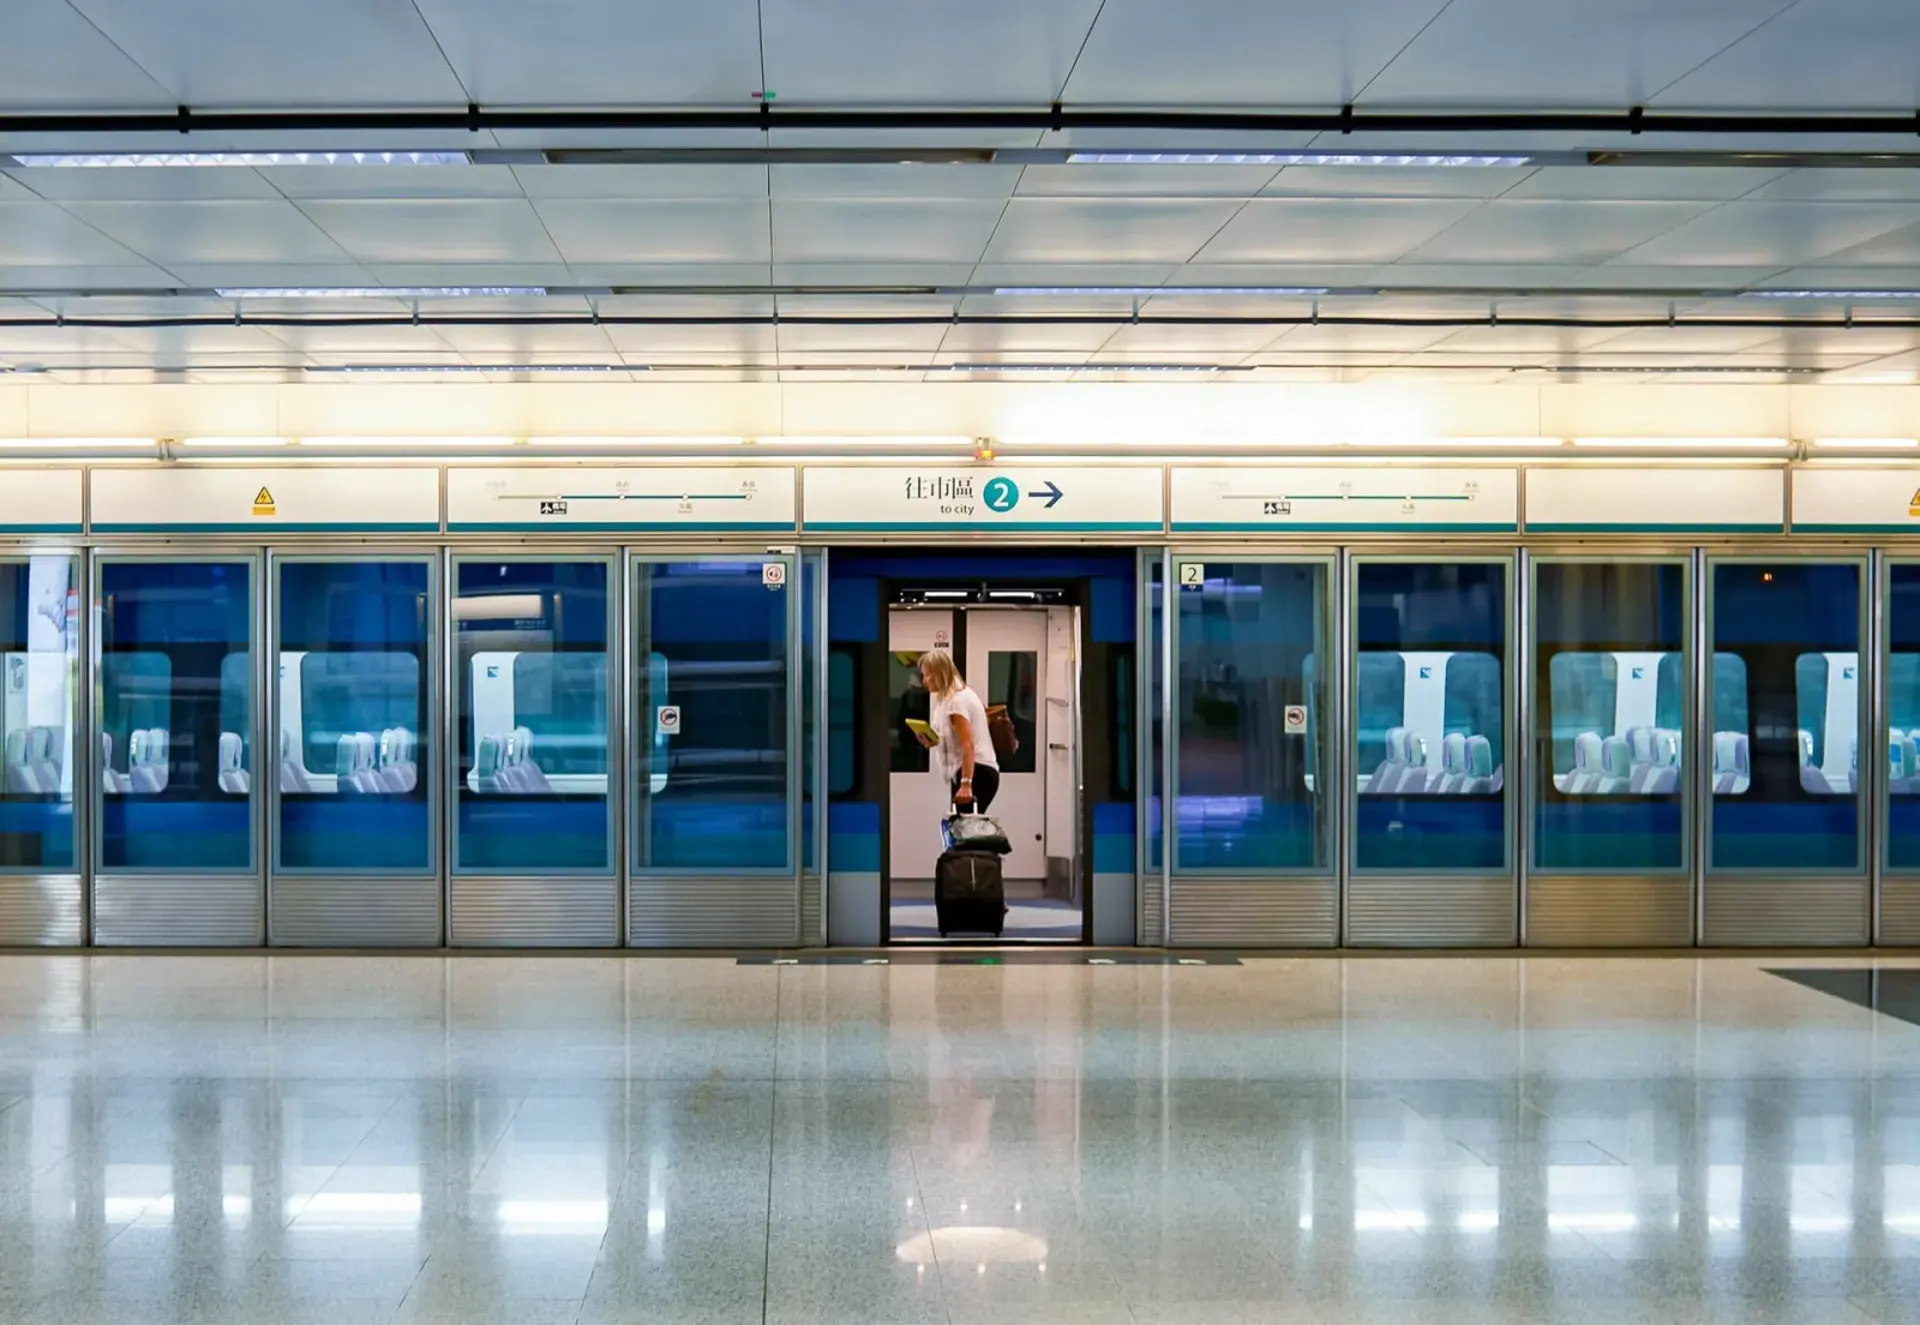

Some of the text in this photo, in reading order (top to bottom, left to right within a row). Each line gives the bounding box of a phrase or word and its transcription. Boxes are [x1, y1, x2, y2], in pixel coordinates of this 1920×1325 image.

[905, 476, 974, 499] 往市區
[993, 483, 1009, 507] 2
[940, 504, 975, 516] to city
[1187, 567, 1198, 582] 2
